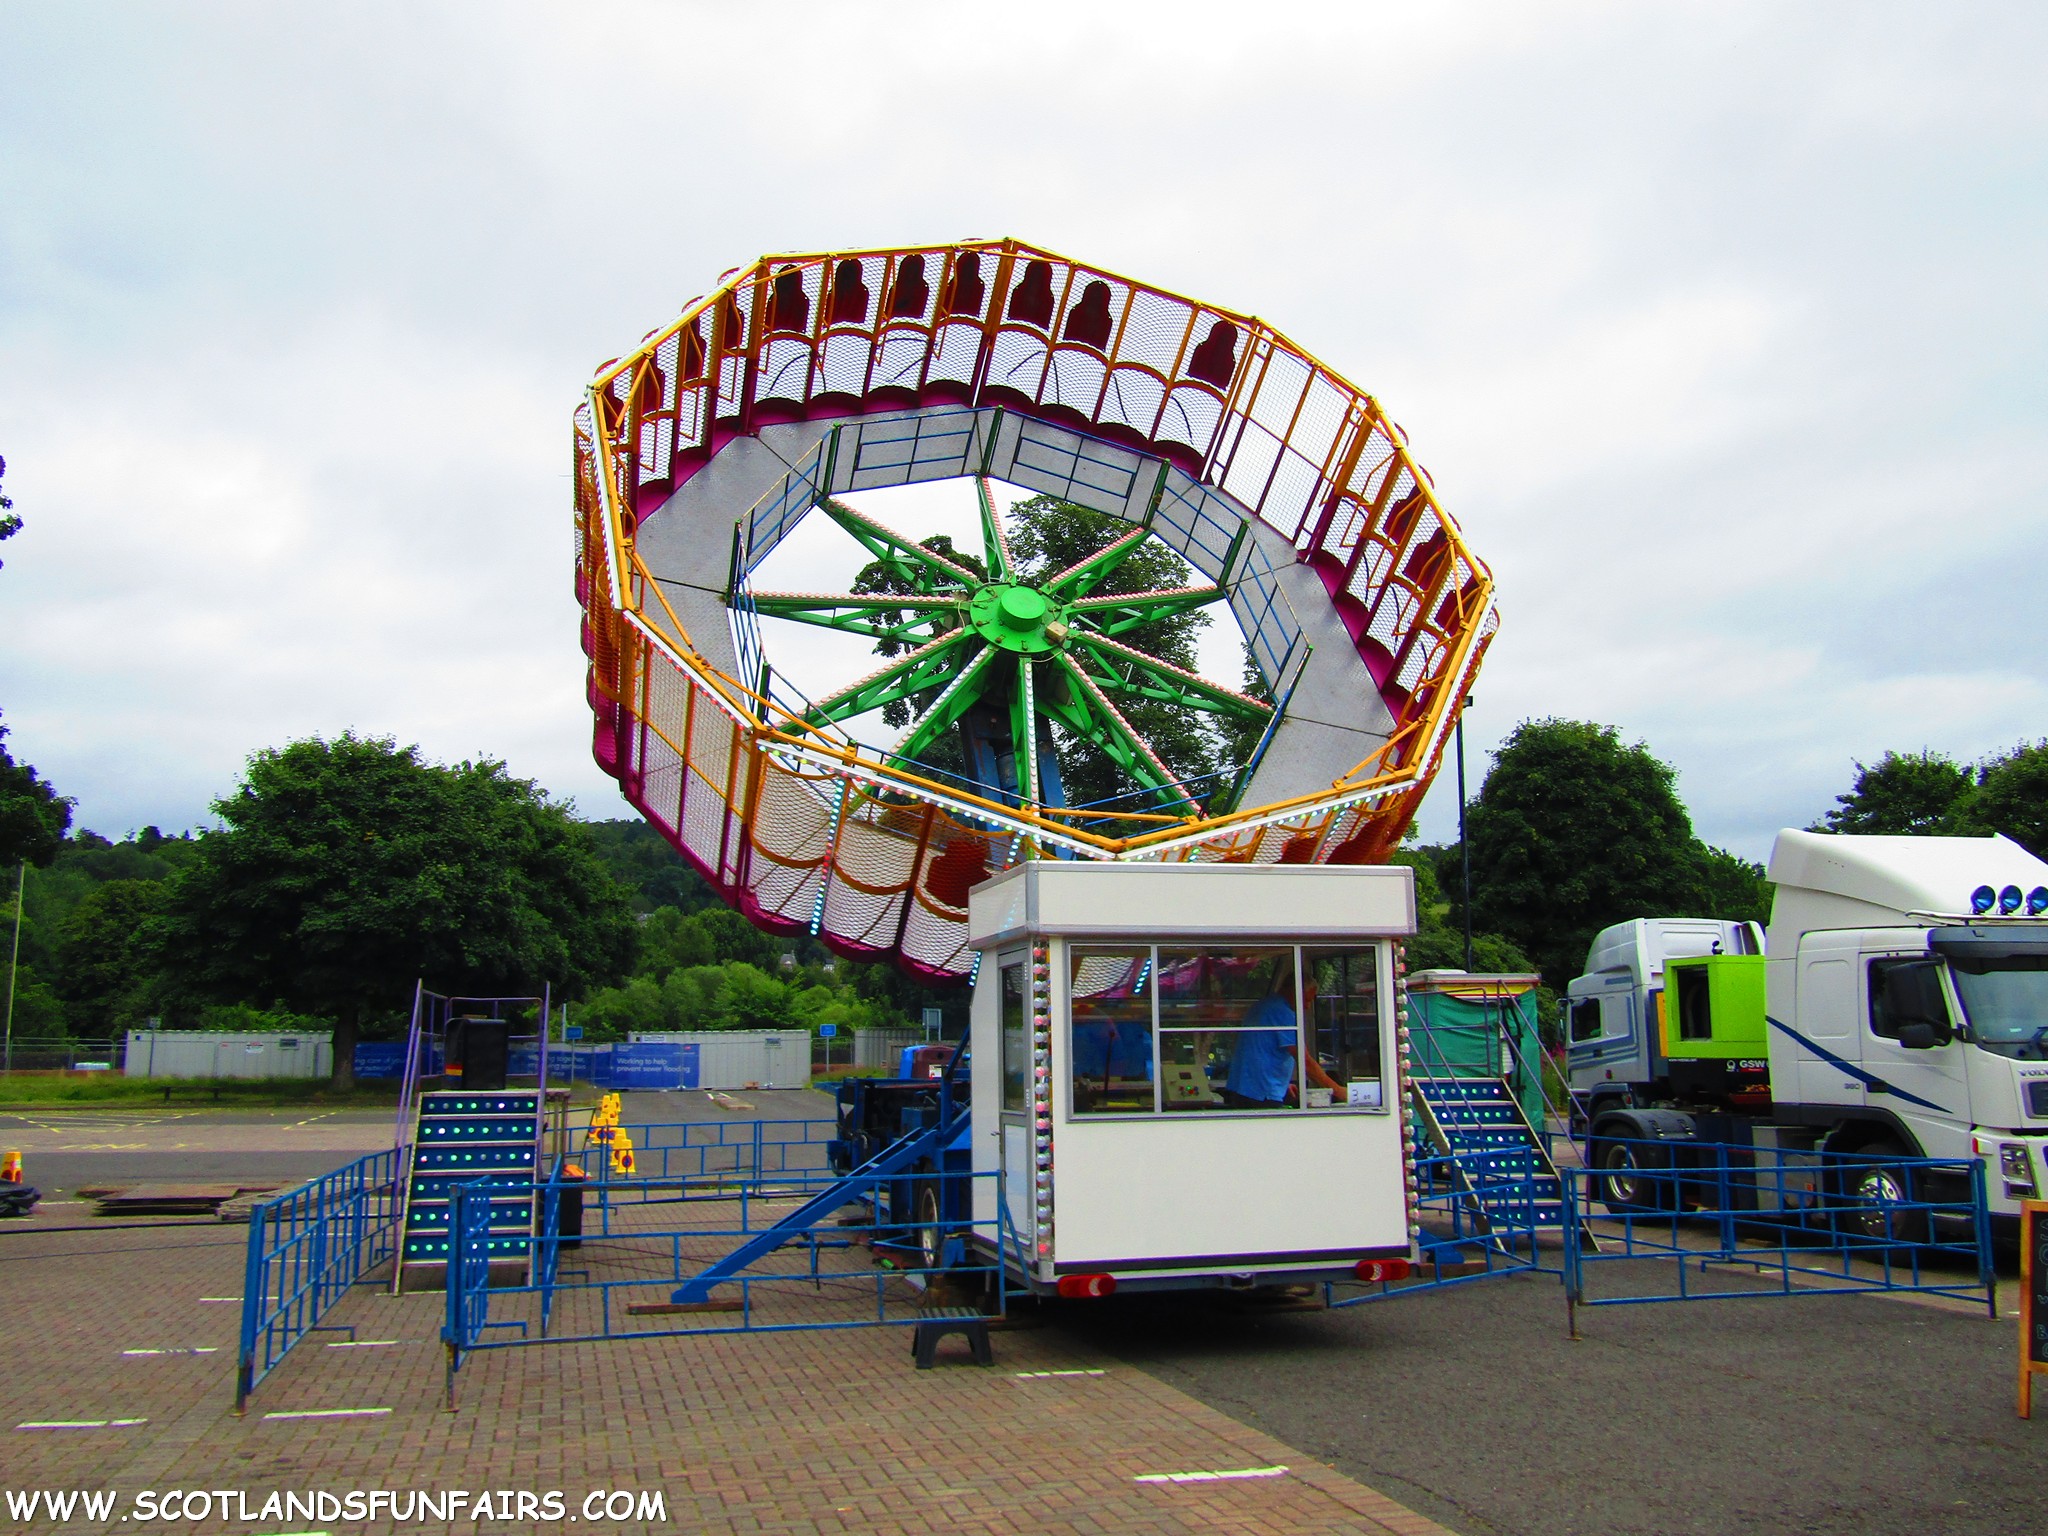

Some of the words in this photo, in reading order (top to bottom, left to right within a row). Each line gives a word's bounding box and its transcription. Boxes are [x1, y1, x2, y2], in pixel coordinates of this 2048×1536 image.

[616, 1058, 644, 1066] Working
[653, 1057, 667, 1065] help
[1740, 1060, 1765, 1068] GSW
